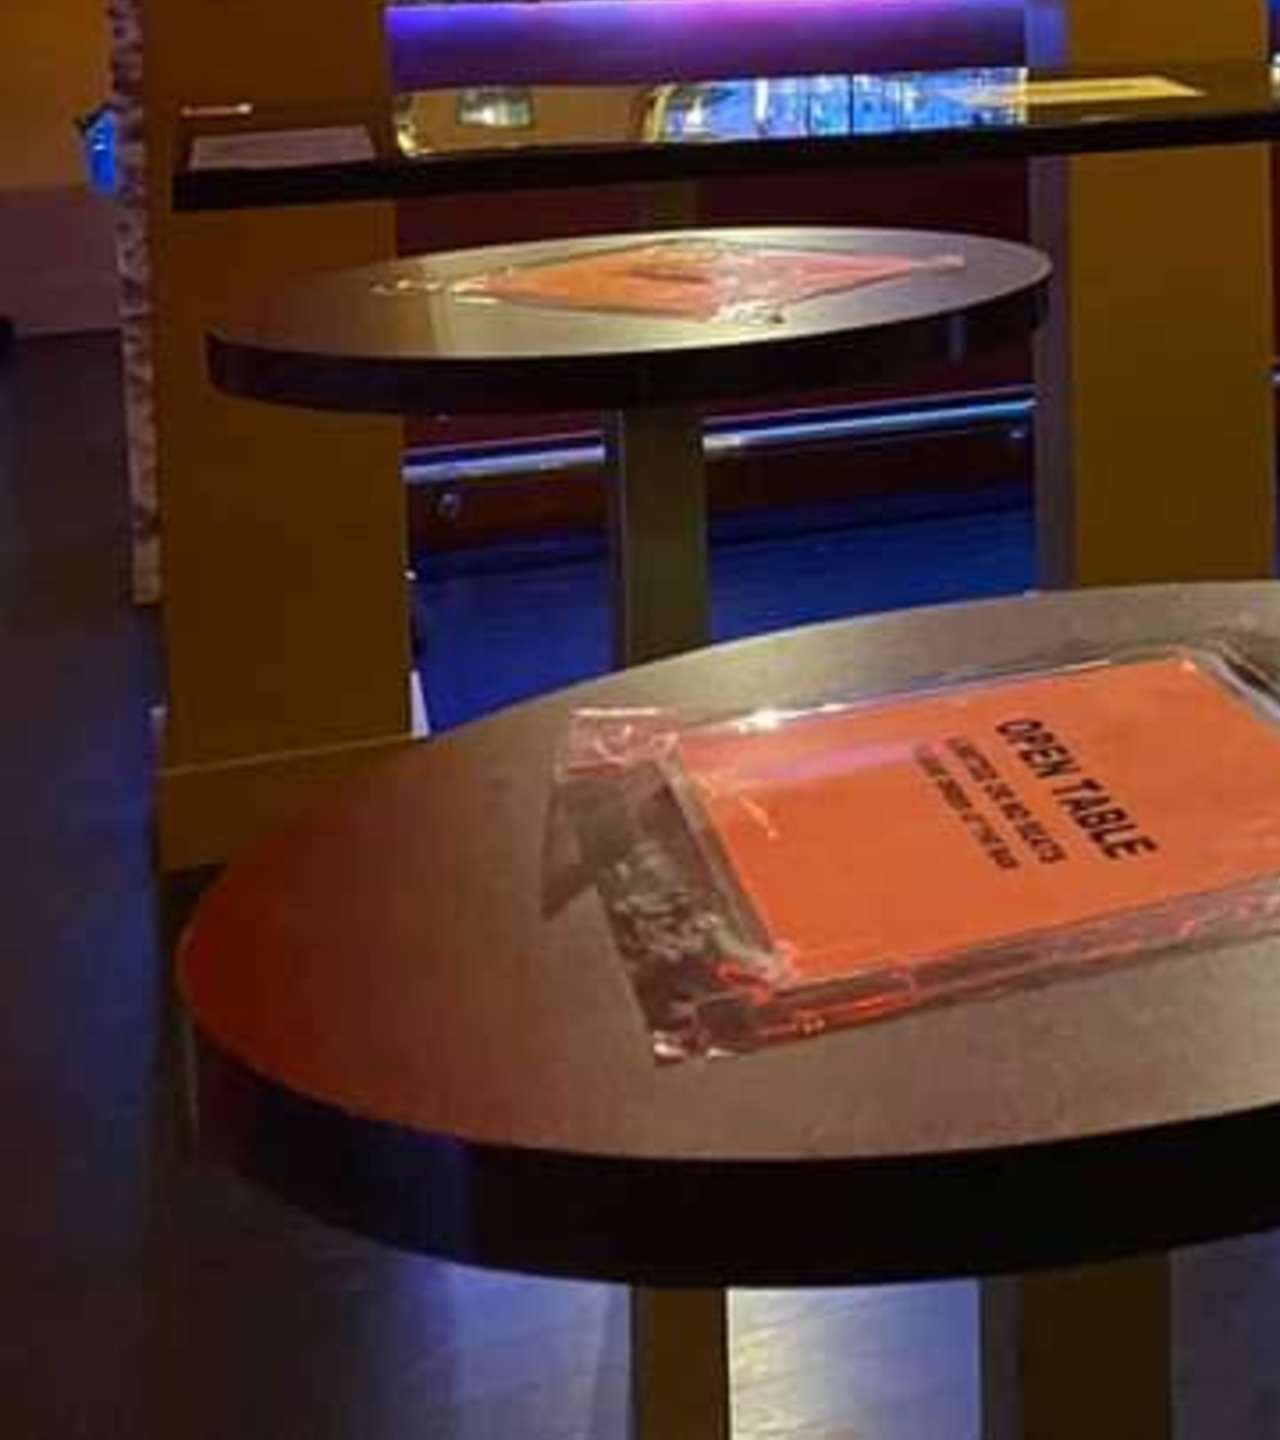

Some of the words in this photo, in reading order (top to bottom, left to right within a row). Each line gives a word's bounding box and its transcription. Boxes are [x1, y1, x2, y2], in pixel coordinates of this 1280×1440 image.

[994, 718, 1083, 780] OPEN
[1051, 777, 1160, 860] TABLE
[1013, 820, 1069, 865] SEATS
